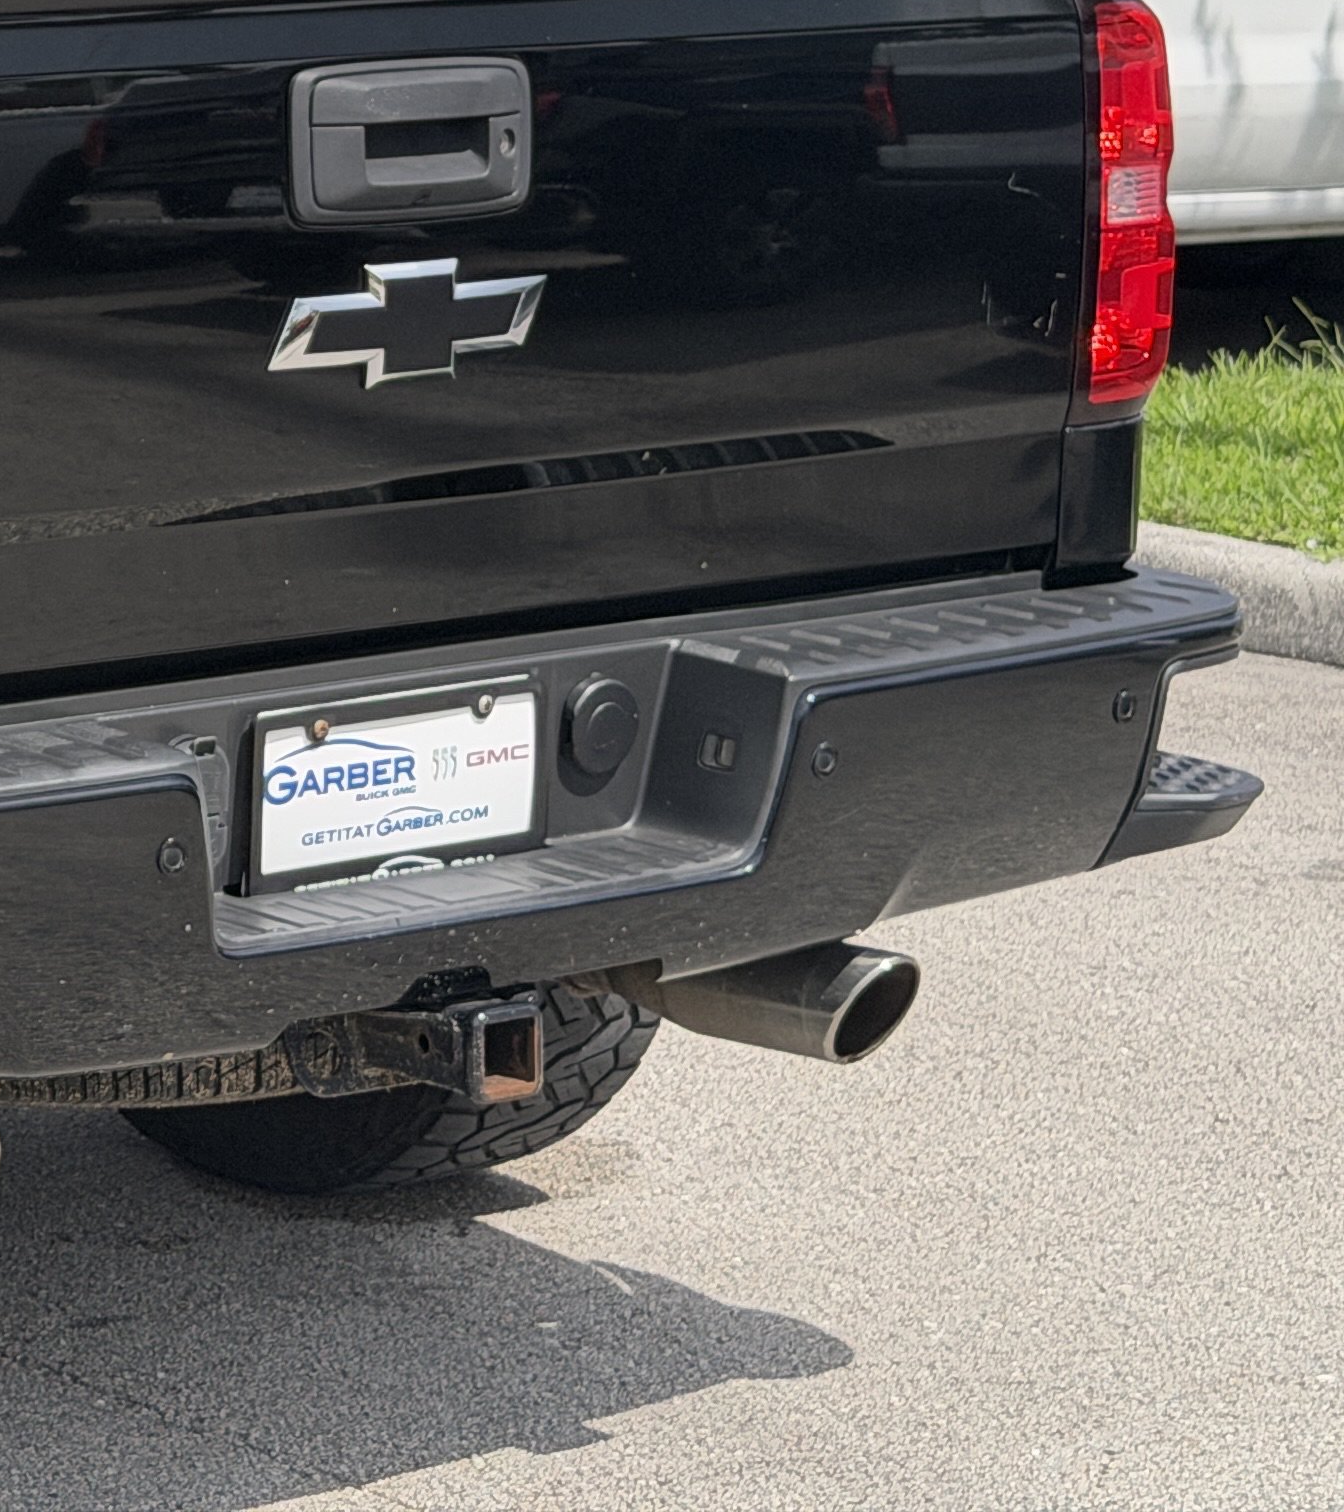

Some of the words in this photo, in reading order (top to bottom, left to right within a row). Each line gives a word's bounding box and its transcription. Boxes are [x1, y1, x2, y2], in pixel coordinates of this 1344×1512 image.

[466, 744, 530, 767] GMC
[263, 755, 416, 806] GARBER
[355, 789, 389, 802] BUICK
[392, 785, 417, 797] GMC
